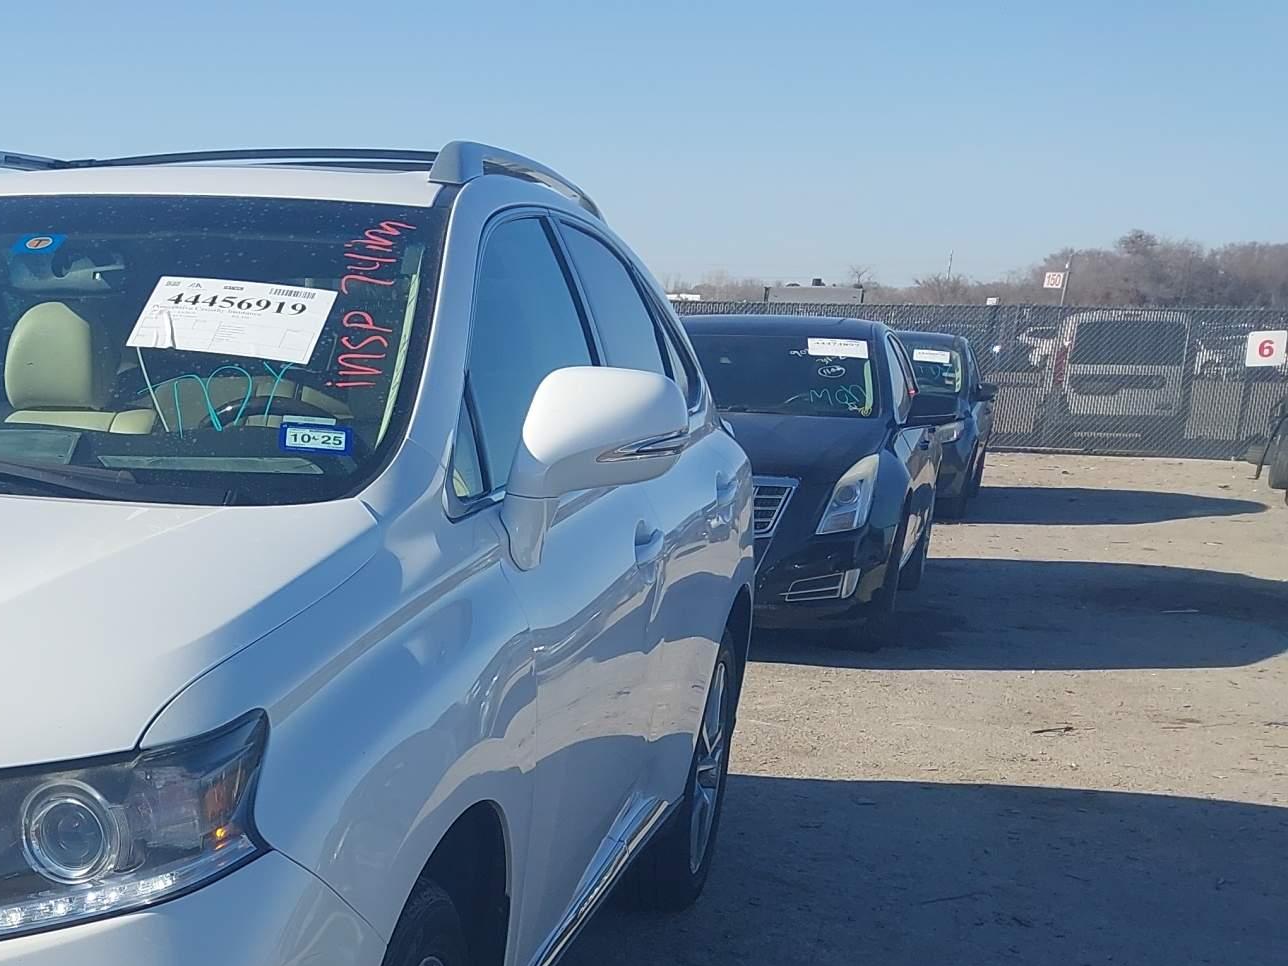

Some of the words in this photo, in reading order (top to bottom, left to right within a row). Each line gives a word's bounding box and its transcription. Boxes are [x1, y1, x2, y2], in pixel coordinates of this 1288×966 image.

[1046, 273, 1062, 287] 150
[167, 292, 308, 316] 44456919
[1258, 339, 1274, 358] 6
